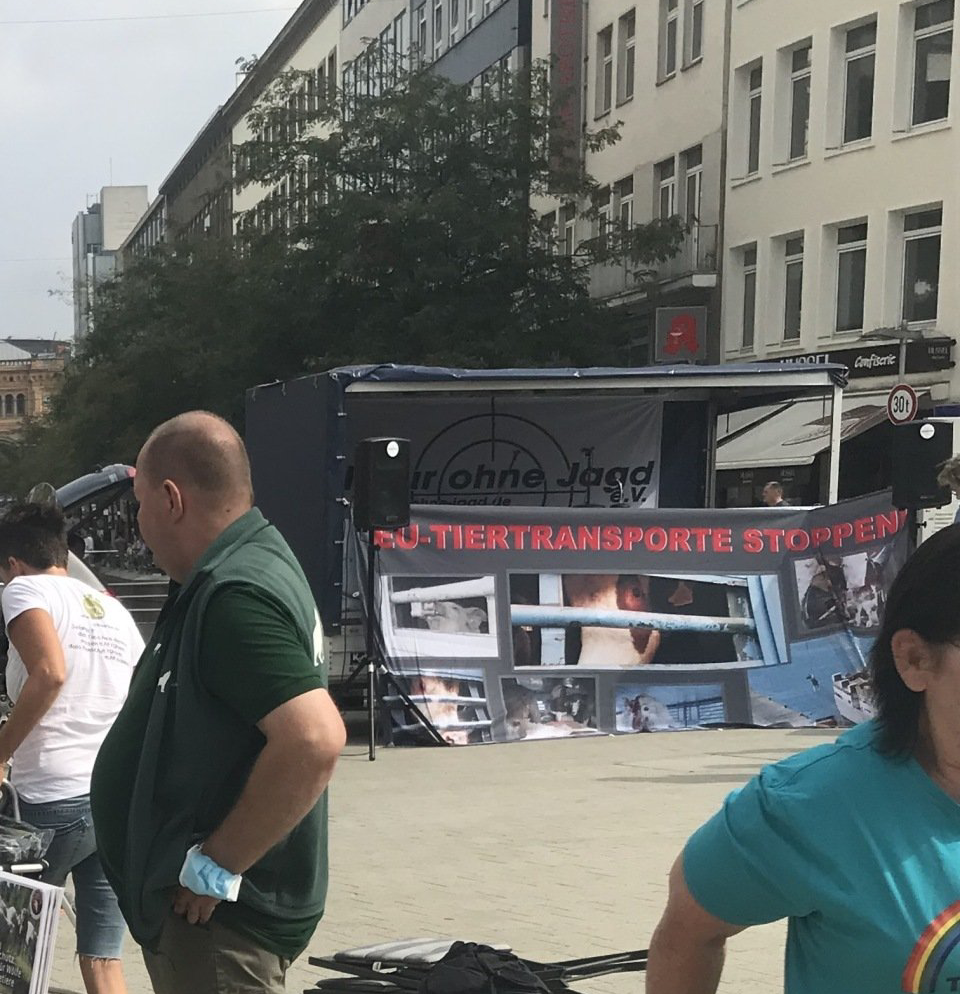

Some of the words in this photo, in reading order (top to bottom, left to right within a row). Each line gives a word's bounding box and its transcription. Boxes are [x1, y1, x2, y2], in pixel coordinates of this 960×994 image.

[854, 353, 897, 369] Confiserie
[448, 463, 546, 490] ohne
[556, 460, 656, 492] Jagd
[373, 523, 733, 553] EU-TIERTRANSPORTE
